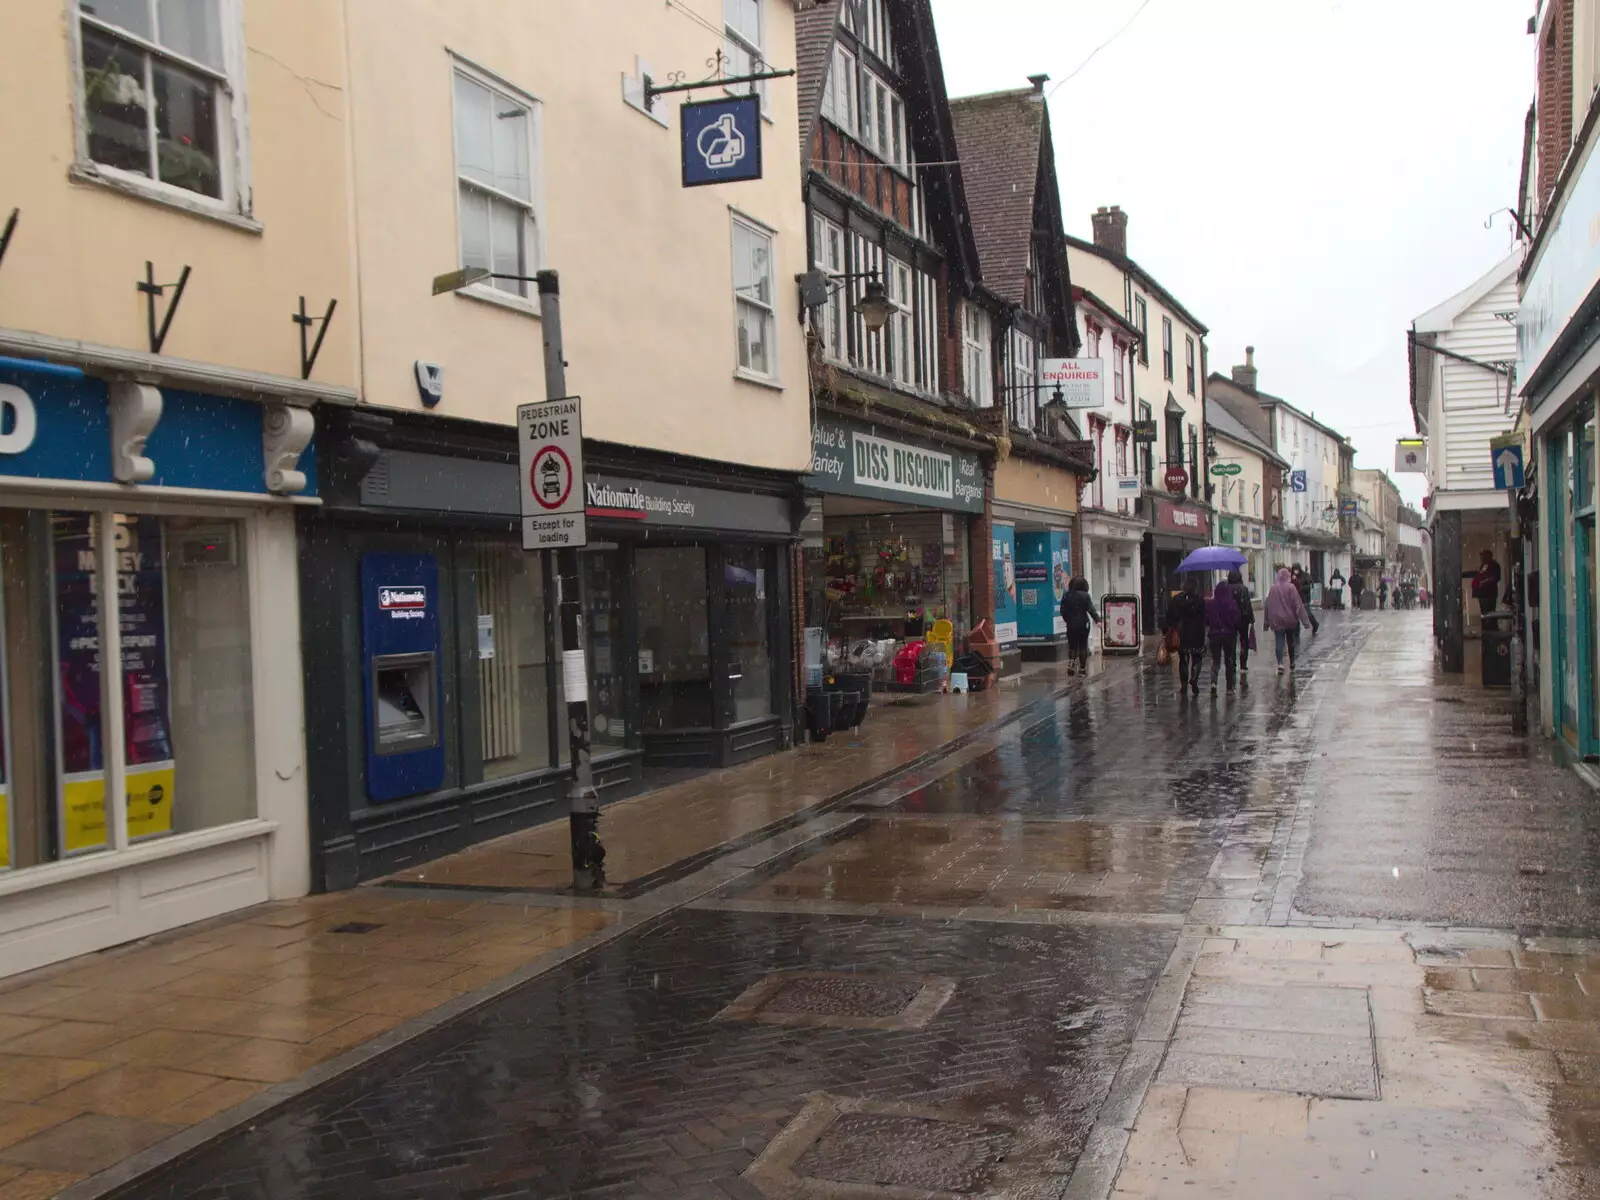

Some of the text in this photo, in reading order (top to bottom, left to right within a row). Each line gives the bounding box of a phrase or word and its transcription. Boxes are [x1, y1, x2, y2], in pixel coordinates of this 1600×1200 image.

[1061, 362, 1080, 370] ALL
[1043, 372, 1099, 380] ENQUIRIES
[521, 403, 577, 420] PEDESTRIAN
[529, 419, 569, 440] ZONE
[838, 430, 846, 449] &
[855, 439, 950, 492] DISS DISCOUNT
[586, 482, 695, 517] Nationwide Building Society
[955, 479, 982, 502] Bargains
[532, 519, 575, 530] Except for
[539, 532, 569, 543] loading
[78, 550, 142, 571] MEY
[390, 591, 425, 603] Nationwide
